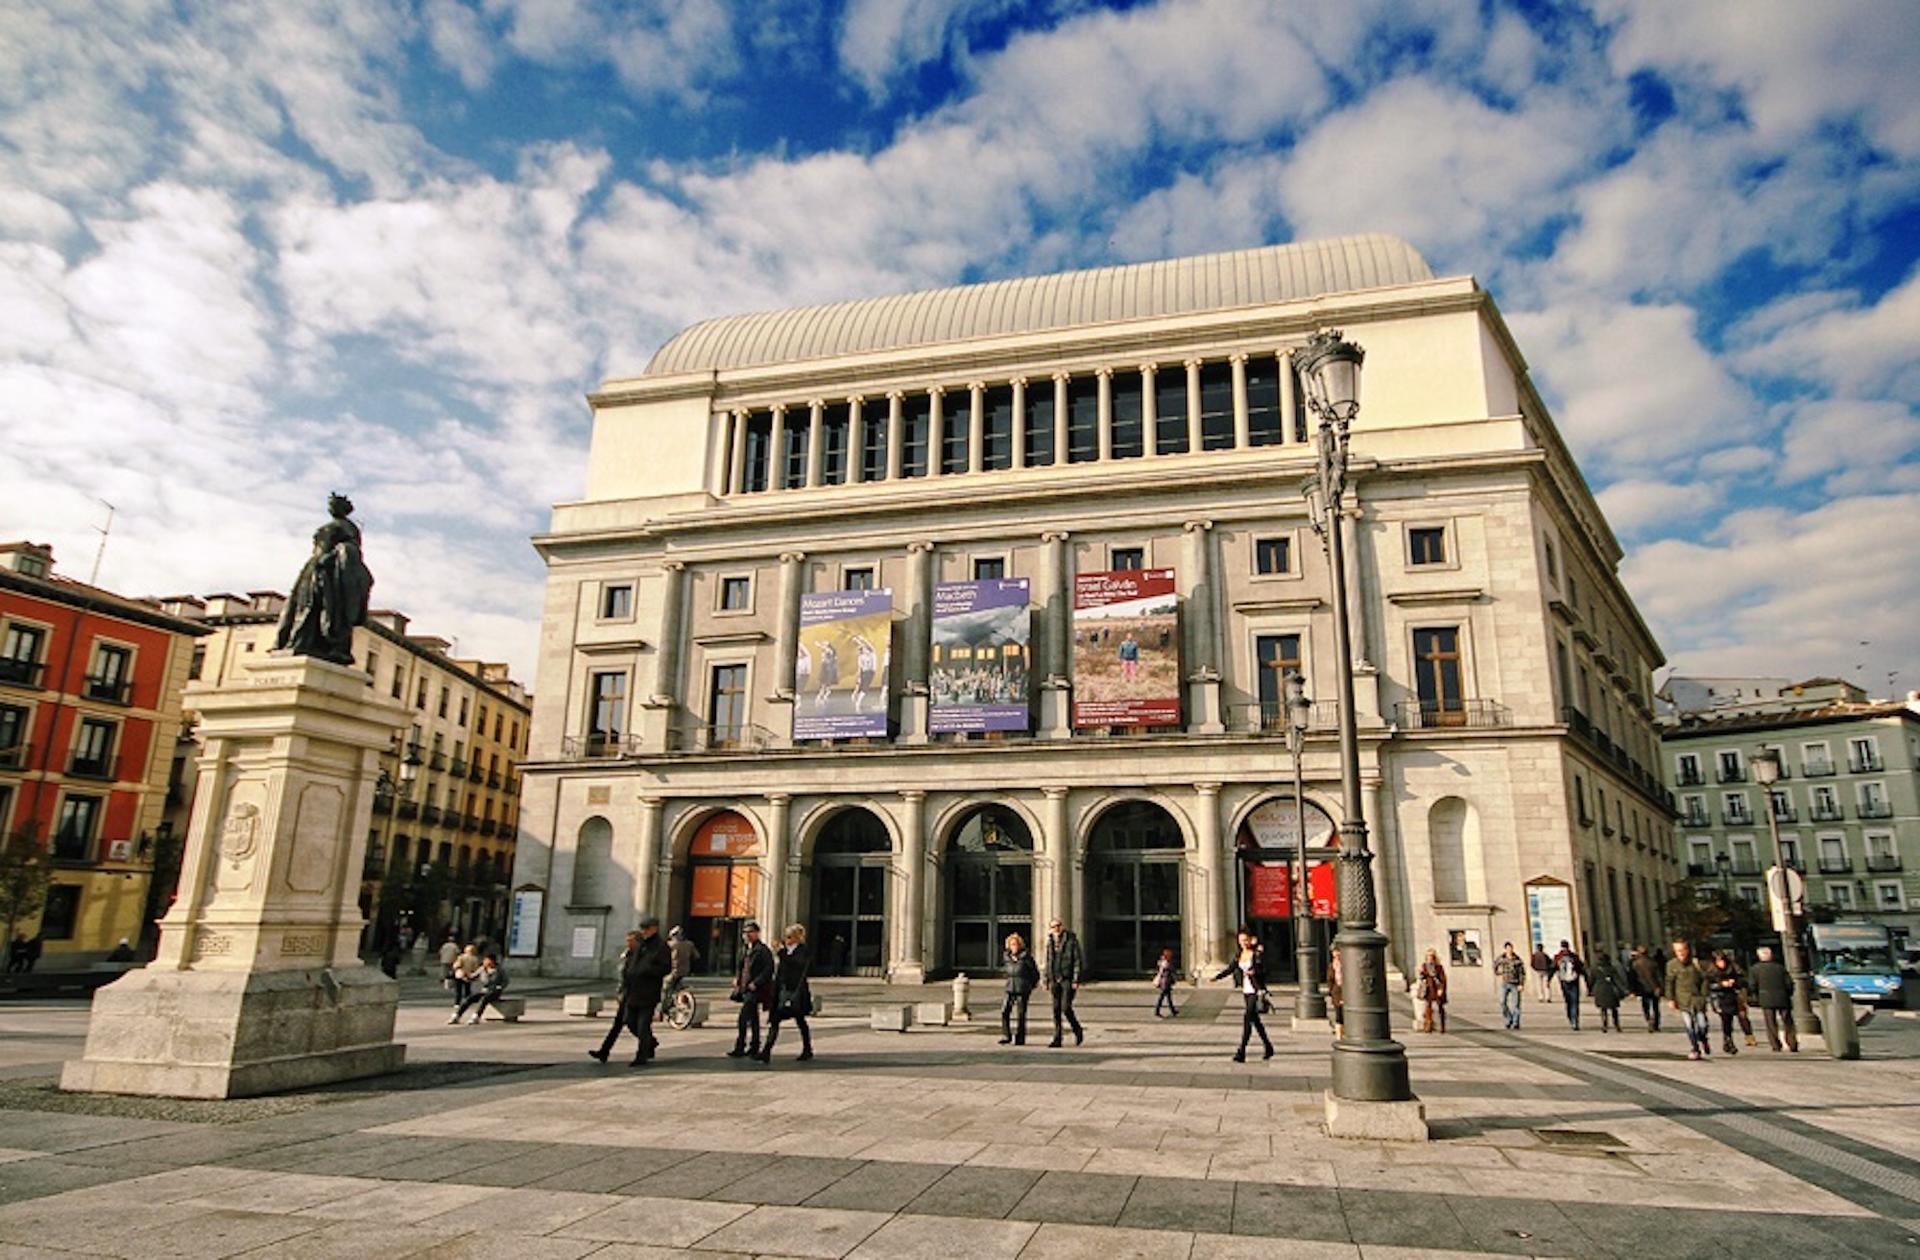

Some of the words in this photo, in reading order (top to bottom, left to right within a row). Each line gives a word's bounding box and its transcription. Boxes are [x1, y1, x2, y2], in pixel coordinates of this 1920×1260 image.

[936, 590, 978, 600] Macbeth
[802, 599, 833, 609] Mozart
[834, 597, 866, 607] Dances
